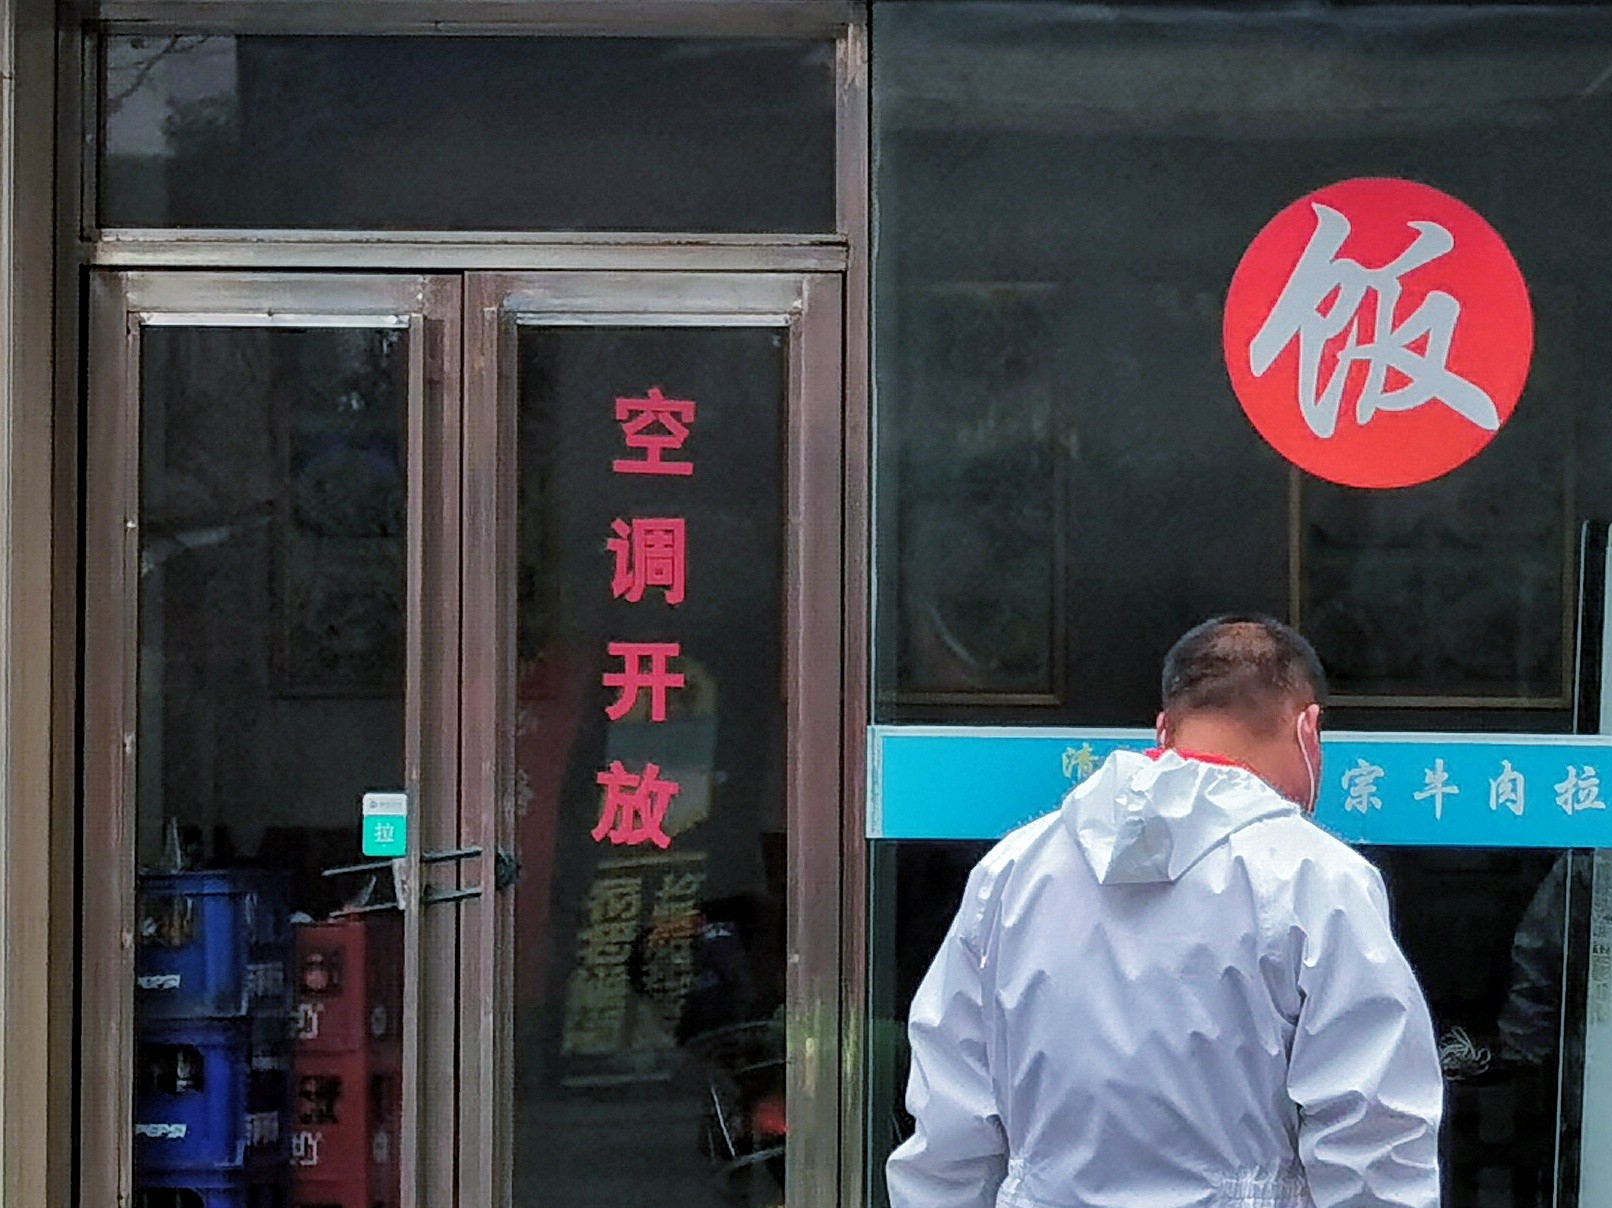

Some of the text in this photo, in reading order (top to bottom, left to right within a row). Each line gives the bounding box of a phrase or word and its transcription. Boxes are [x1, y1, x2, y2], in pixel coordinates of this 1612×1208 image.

[1249, 202, 1501, 440] 饭
[591, 387, 697, 849] 空调开放
[373, 821, 396, 844] 拉
